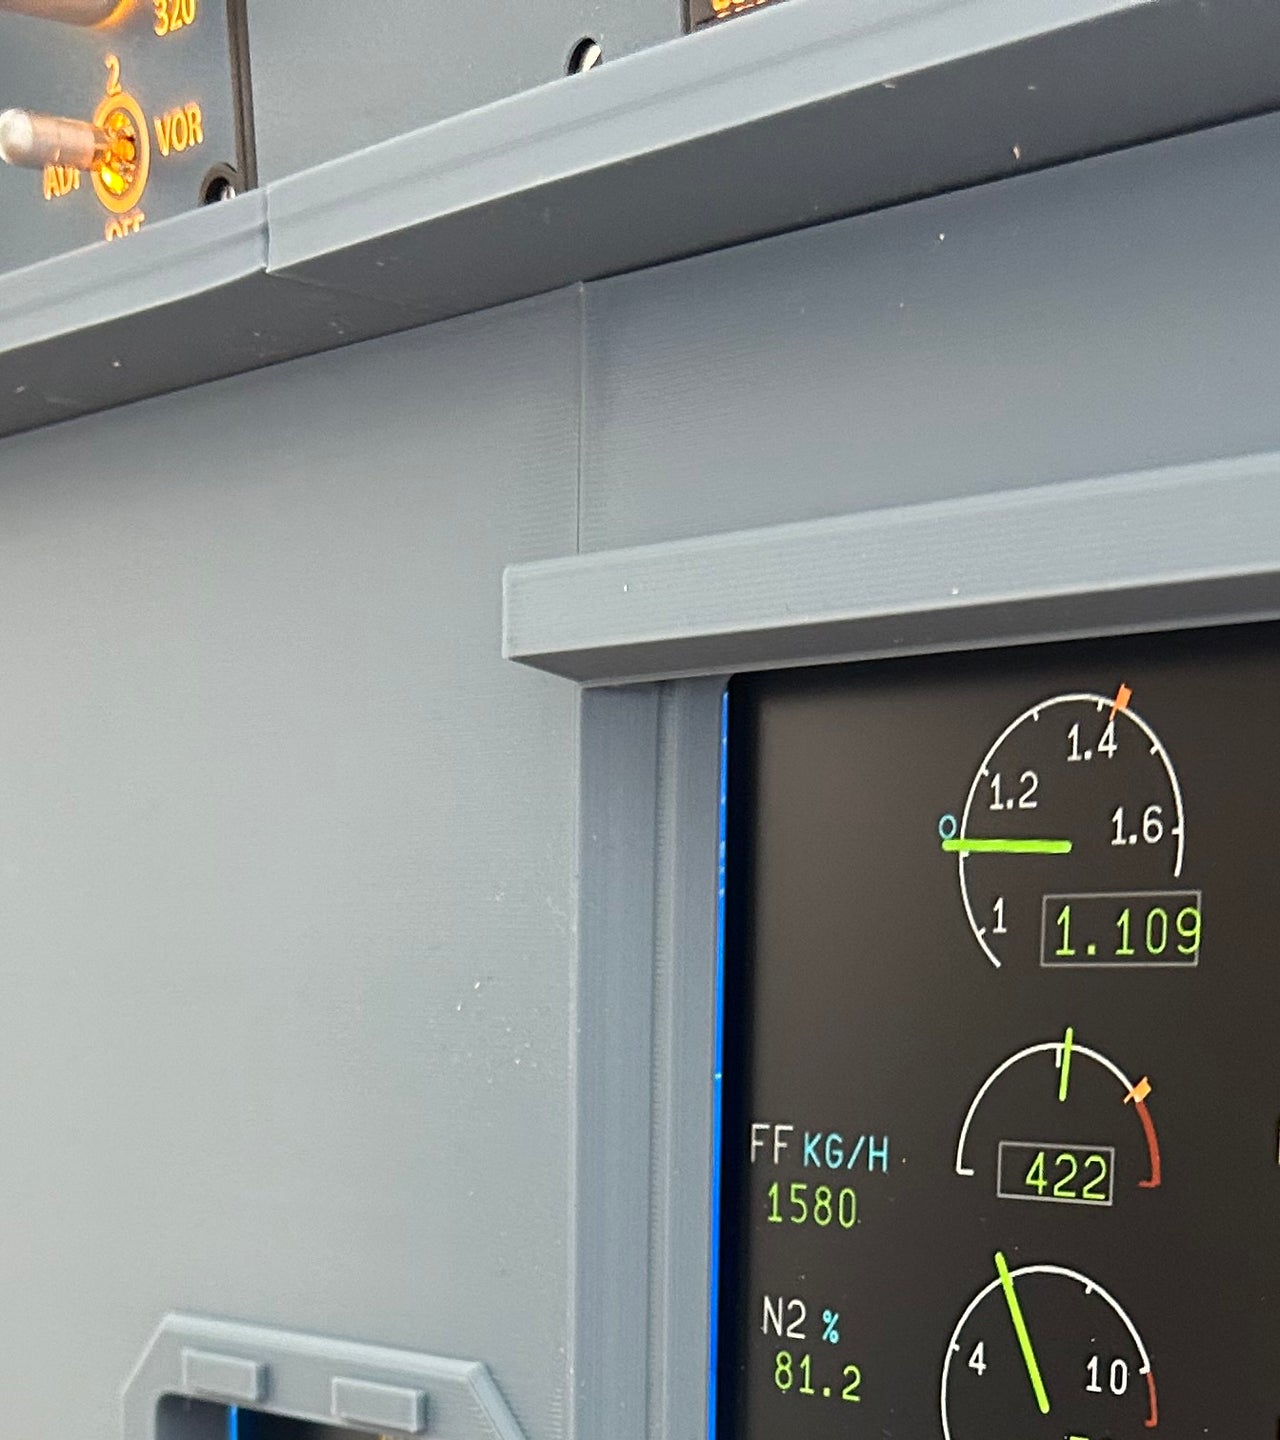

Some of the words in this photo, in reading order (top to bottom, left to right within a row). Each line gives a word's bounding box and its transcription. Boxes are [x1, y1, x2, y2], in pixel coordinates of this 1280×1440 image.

[105, 54, 122, 94] 2
[154, 102, 204, 157] VOR
[1066, 722, 1118, 761] 1.4
[989, 772, 1039, 809] 1.2
[1111, 806, 1163, 844] 1.6
[992, 897, 1007, 932] 1
[1055, 906, 1202, 957] 1.109
[750, 1125, 793, 1164] FF
[803, 1134, 889, 1173] KG/H
[1025, 1154, 1108, 1200] 422
[767, 1182, 857, 1228] 1580
[761, 1296, 807, 1339] N2
[822, 1310, 839, 1344] %
[774, 1352, 861, 1402] 81.2
[969, 1342, 987, 1375] 4
[1086, 1357, 1129, 1395] 10
